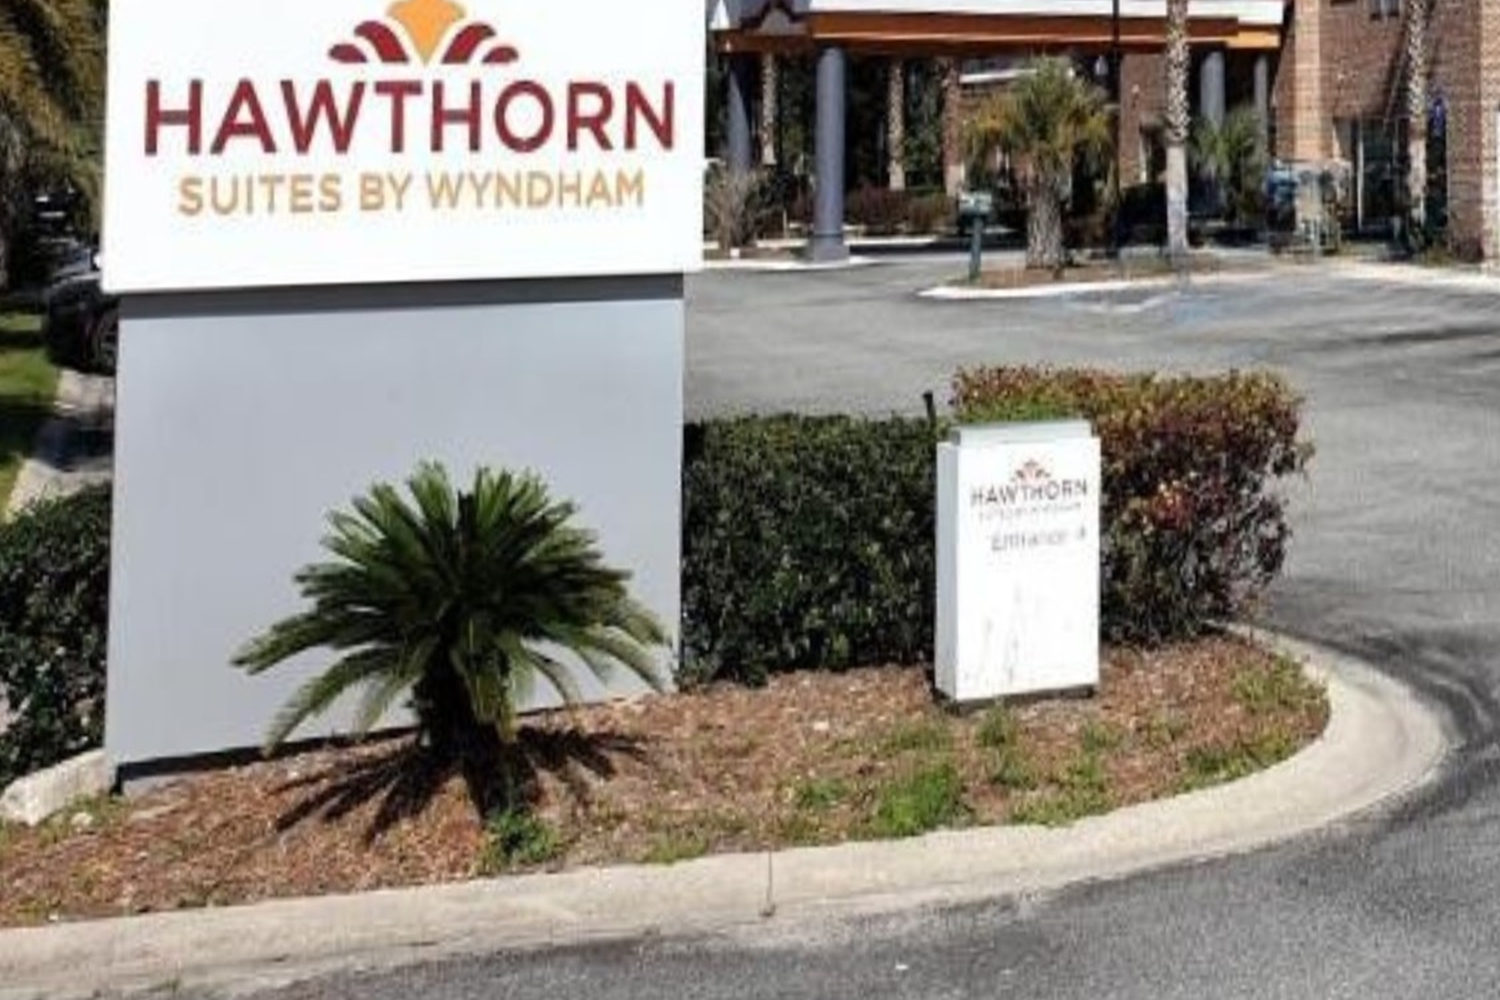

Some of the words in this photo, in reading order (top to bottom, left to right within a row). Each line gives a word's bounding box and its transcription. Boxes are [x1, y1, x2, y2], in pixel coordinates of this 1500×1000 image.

[144, 78, 676, 157] HAWTHORN
[179, 173, 341, 216] SUITES
[360, 173, 412, 211] BY
[427, 170, 644, 208] WYNDHAM
[970, 479, 1087, 506] HAWTHORN
